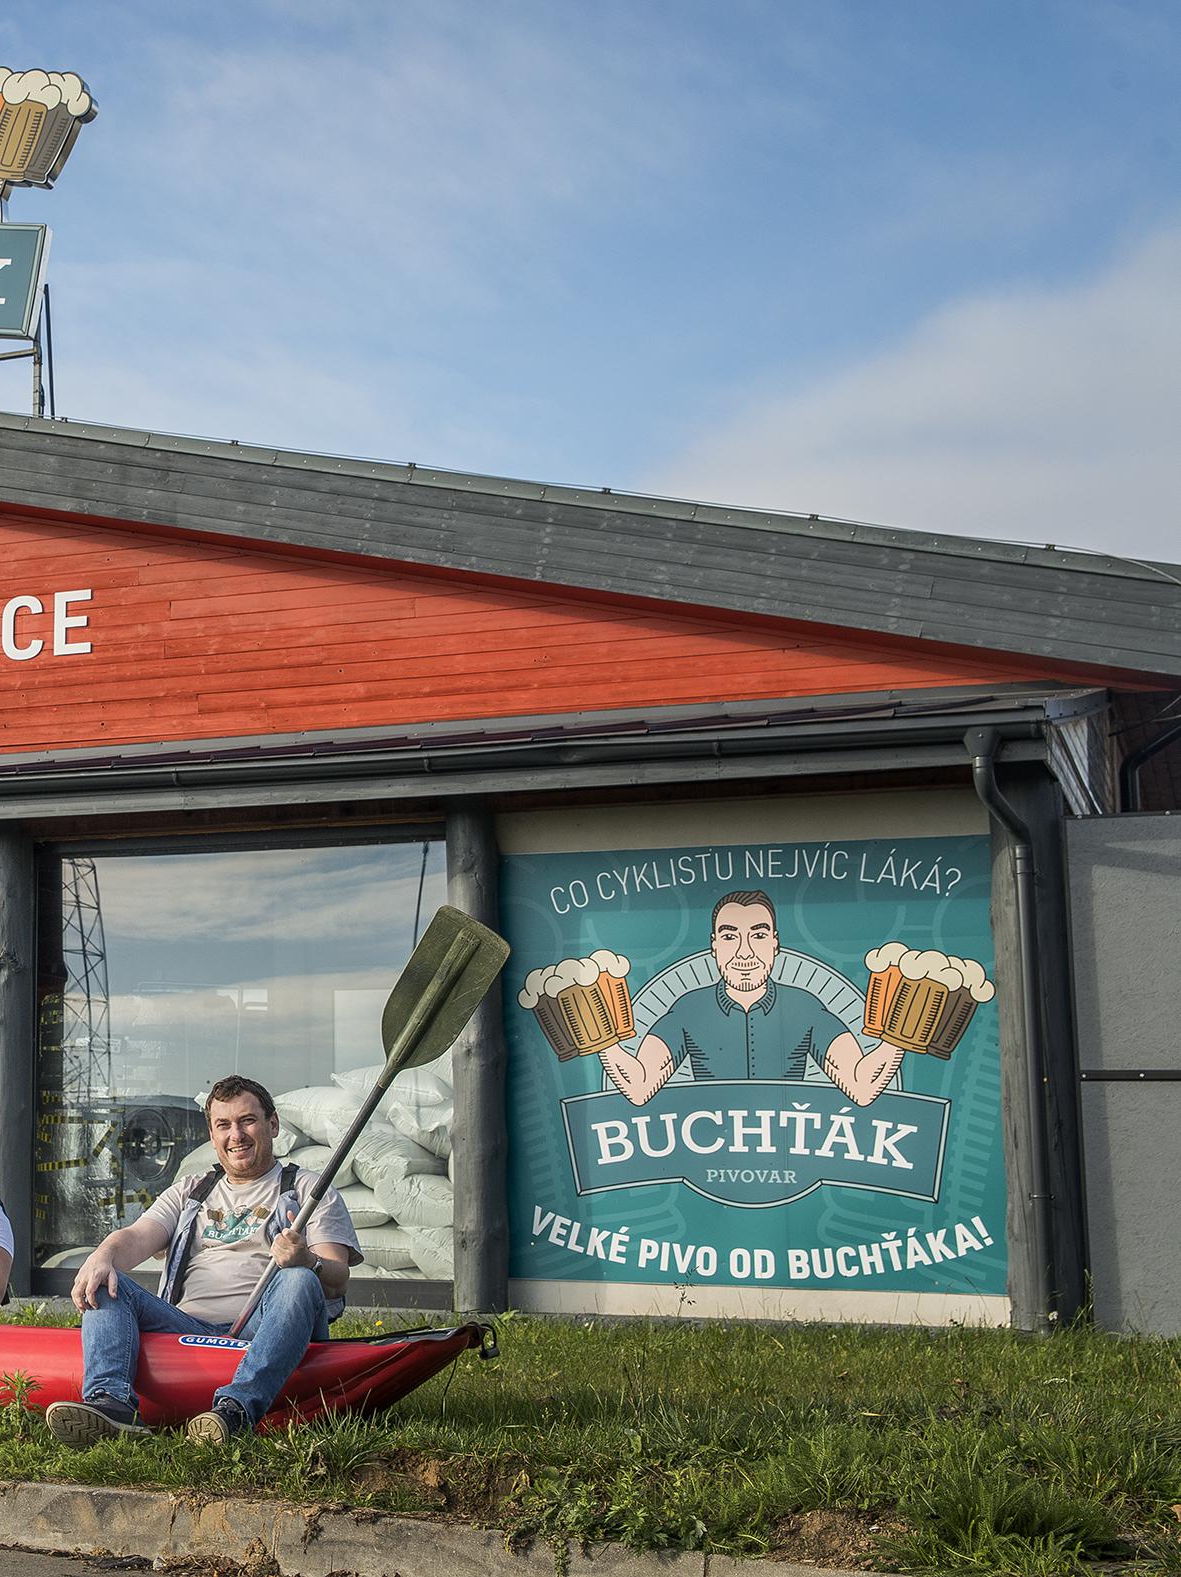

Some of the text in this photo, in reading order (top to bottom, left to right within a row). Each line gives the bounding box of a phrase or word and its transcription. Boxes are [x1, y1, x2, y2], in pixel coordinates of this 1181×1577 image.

[550, 880, 589, 914] CO
[745, 842, 849, 880] NEJVÍC
[859, 848, 962, 897] LÁKÁ?
[591, 1102, 918, 1170] BUCHŤÁK
[706, 1169, 797, 1184] PIVOVAR
[532, 1205, 994, 1280] VELKÉ PIVO OD BUCHŤÁKA!
[185, 1334, 249, 1348] GUMOTE
